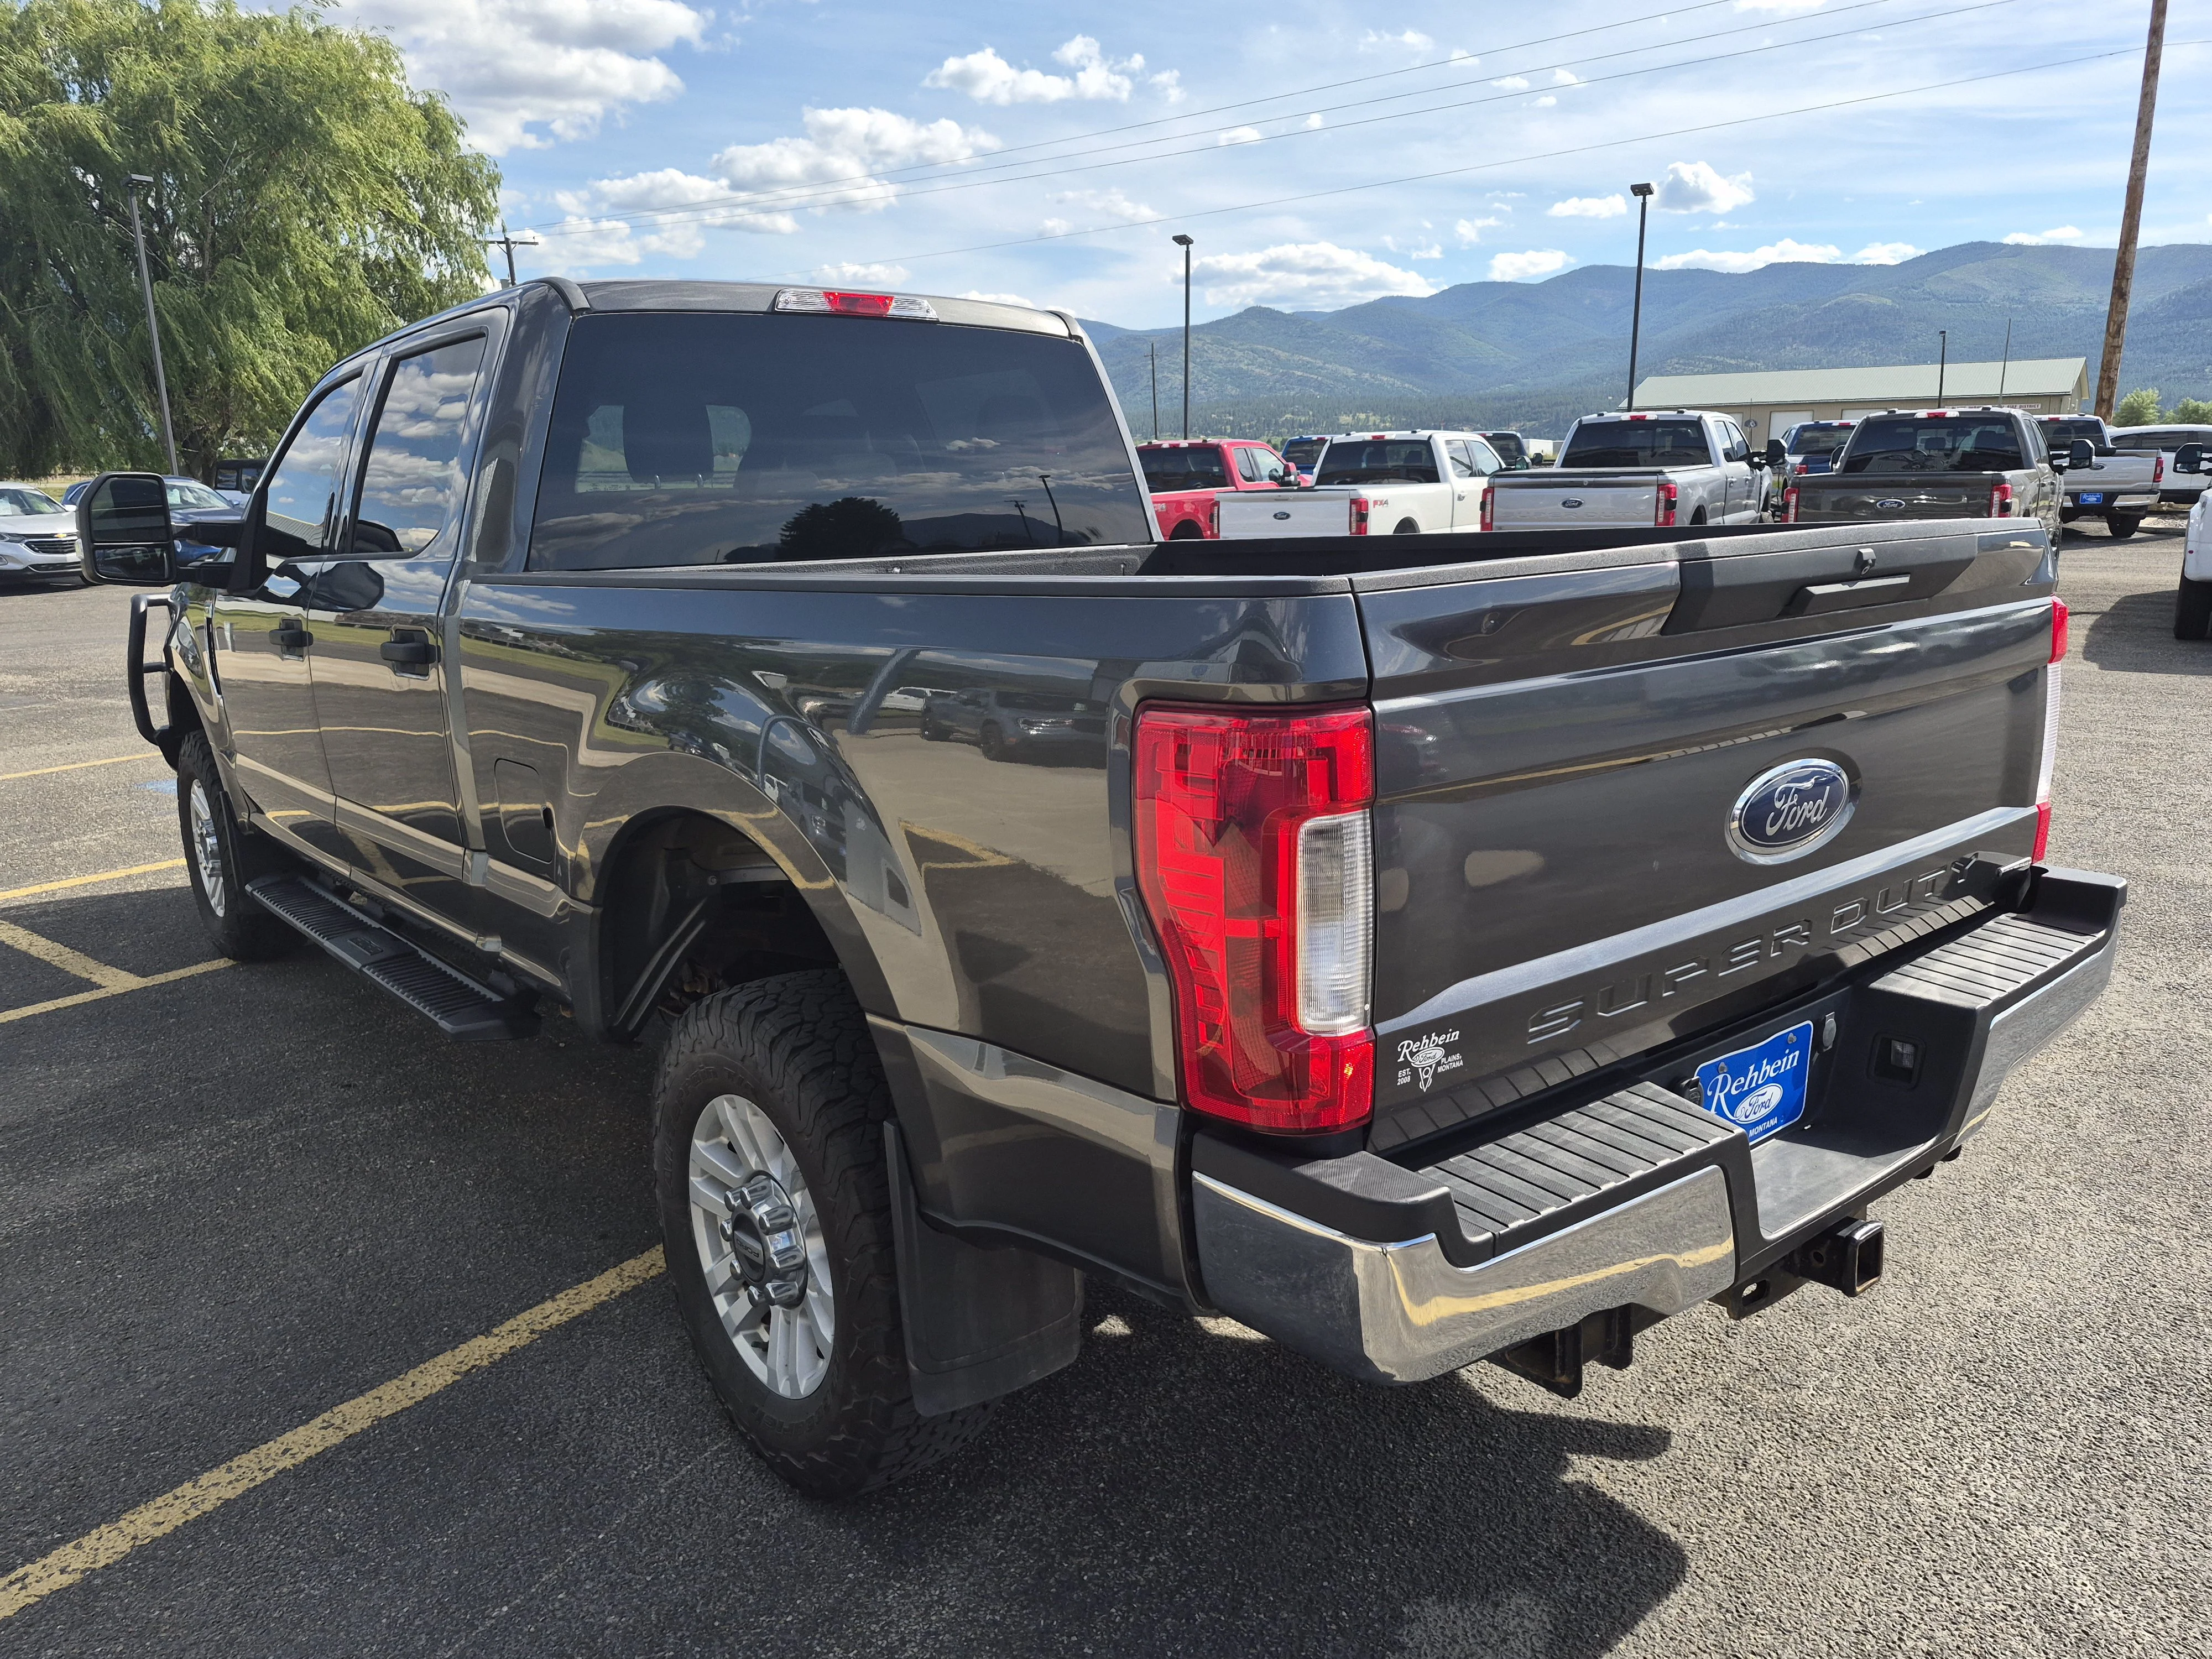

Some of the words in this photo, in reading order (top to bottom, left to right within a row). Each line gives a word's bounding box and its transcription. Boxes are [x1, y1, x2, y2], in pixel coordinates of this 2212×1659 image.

[1766, 775, 1830, 836] Ford
[1527, 919, 1812, 1044] SUPER
[1830, 852, 1979, 935] DUTY
[1397, 1029, 1459, 1062] Rehbein
[1419, 1051, 1437, 1063] Ford
[1437, 1060, 1464, 1073] MONTANA
[1441, 1053, 1462, 1065] PLAINS,
[1397, 1076, 1411, 1086] 2008
[1398, 1068, 1411, 1078] EST.
[1707, 1048, 1800, 1120] Rehbein
[1744, 1091, 1774, 1119] Ford
[1749, 1116, 1778, 1138] MONTANA
[736, 1238, 760, 1259] FORD
